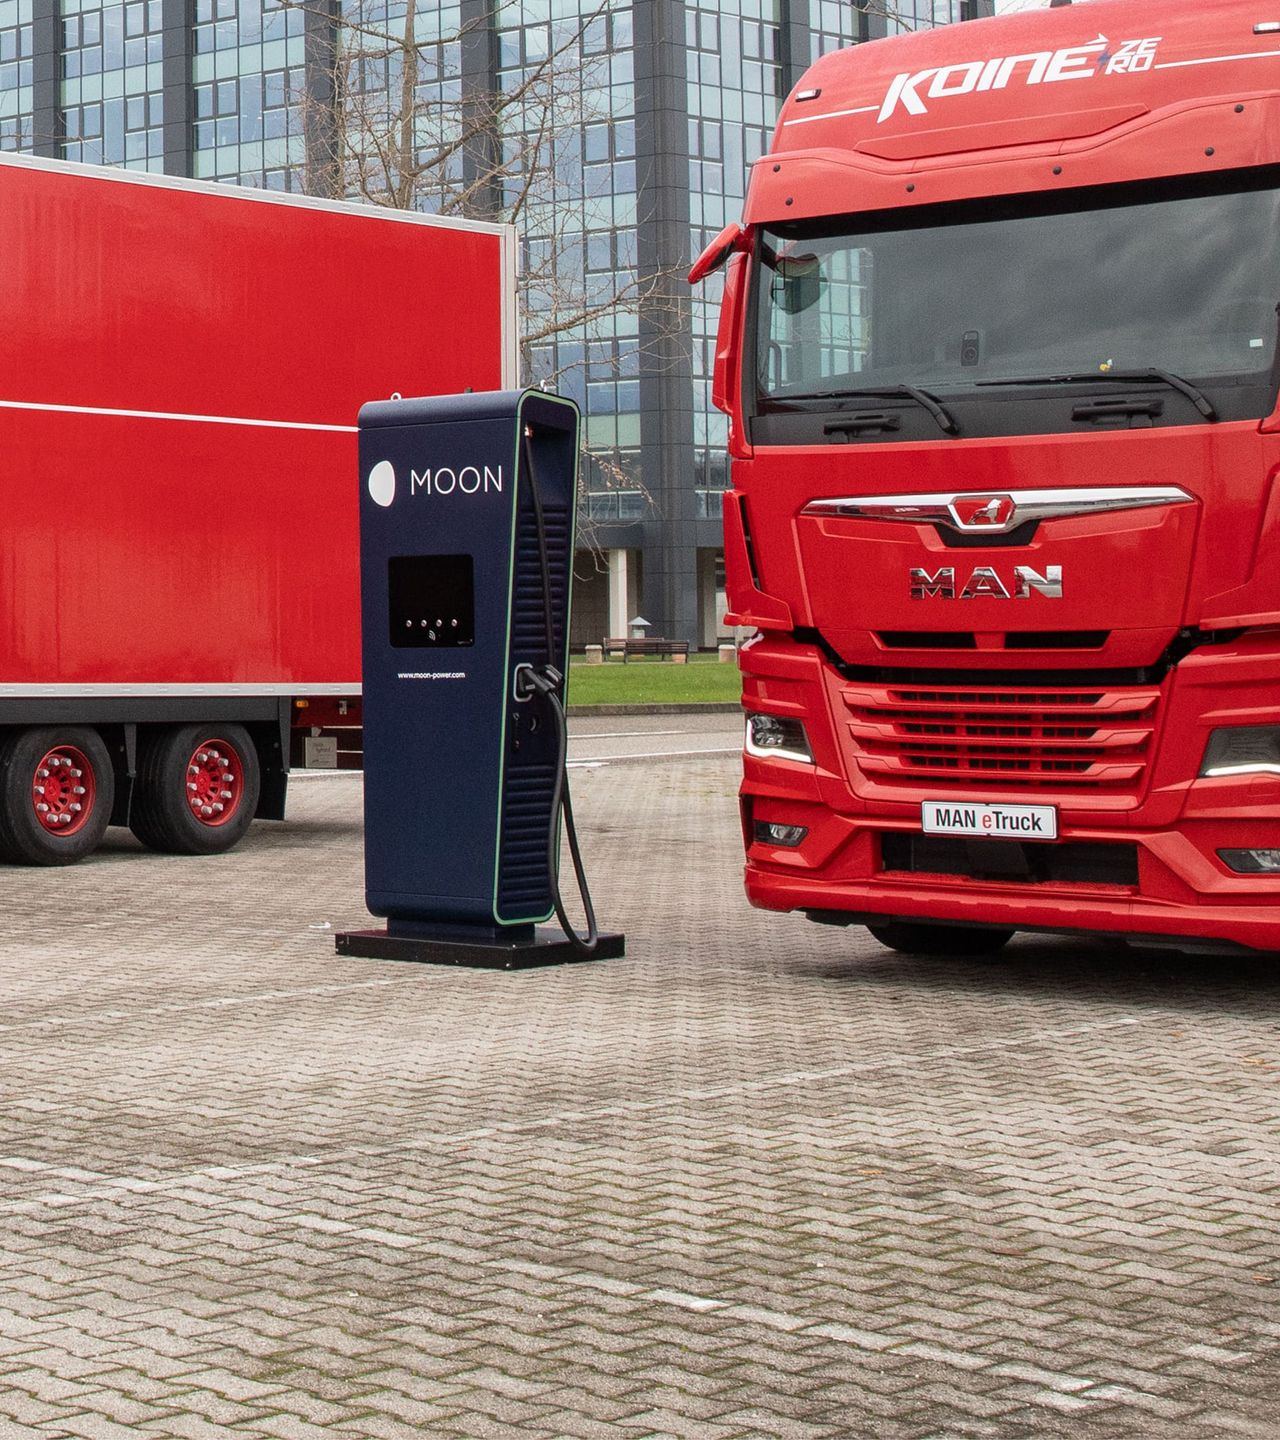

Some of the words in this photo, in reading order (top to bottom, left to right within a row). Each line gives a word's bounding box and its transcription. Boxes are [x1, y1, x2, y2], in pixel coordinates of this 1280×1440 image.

[411, 465, 503, 496] MOON
[909, 565, 1064, 600] MAN
[935, 807, 976, 829] MAN
[982, 811, 1043, 832] eTruck
